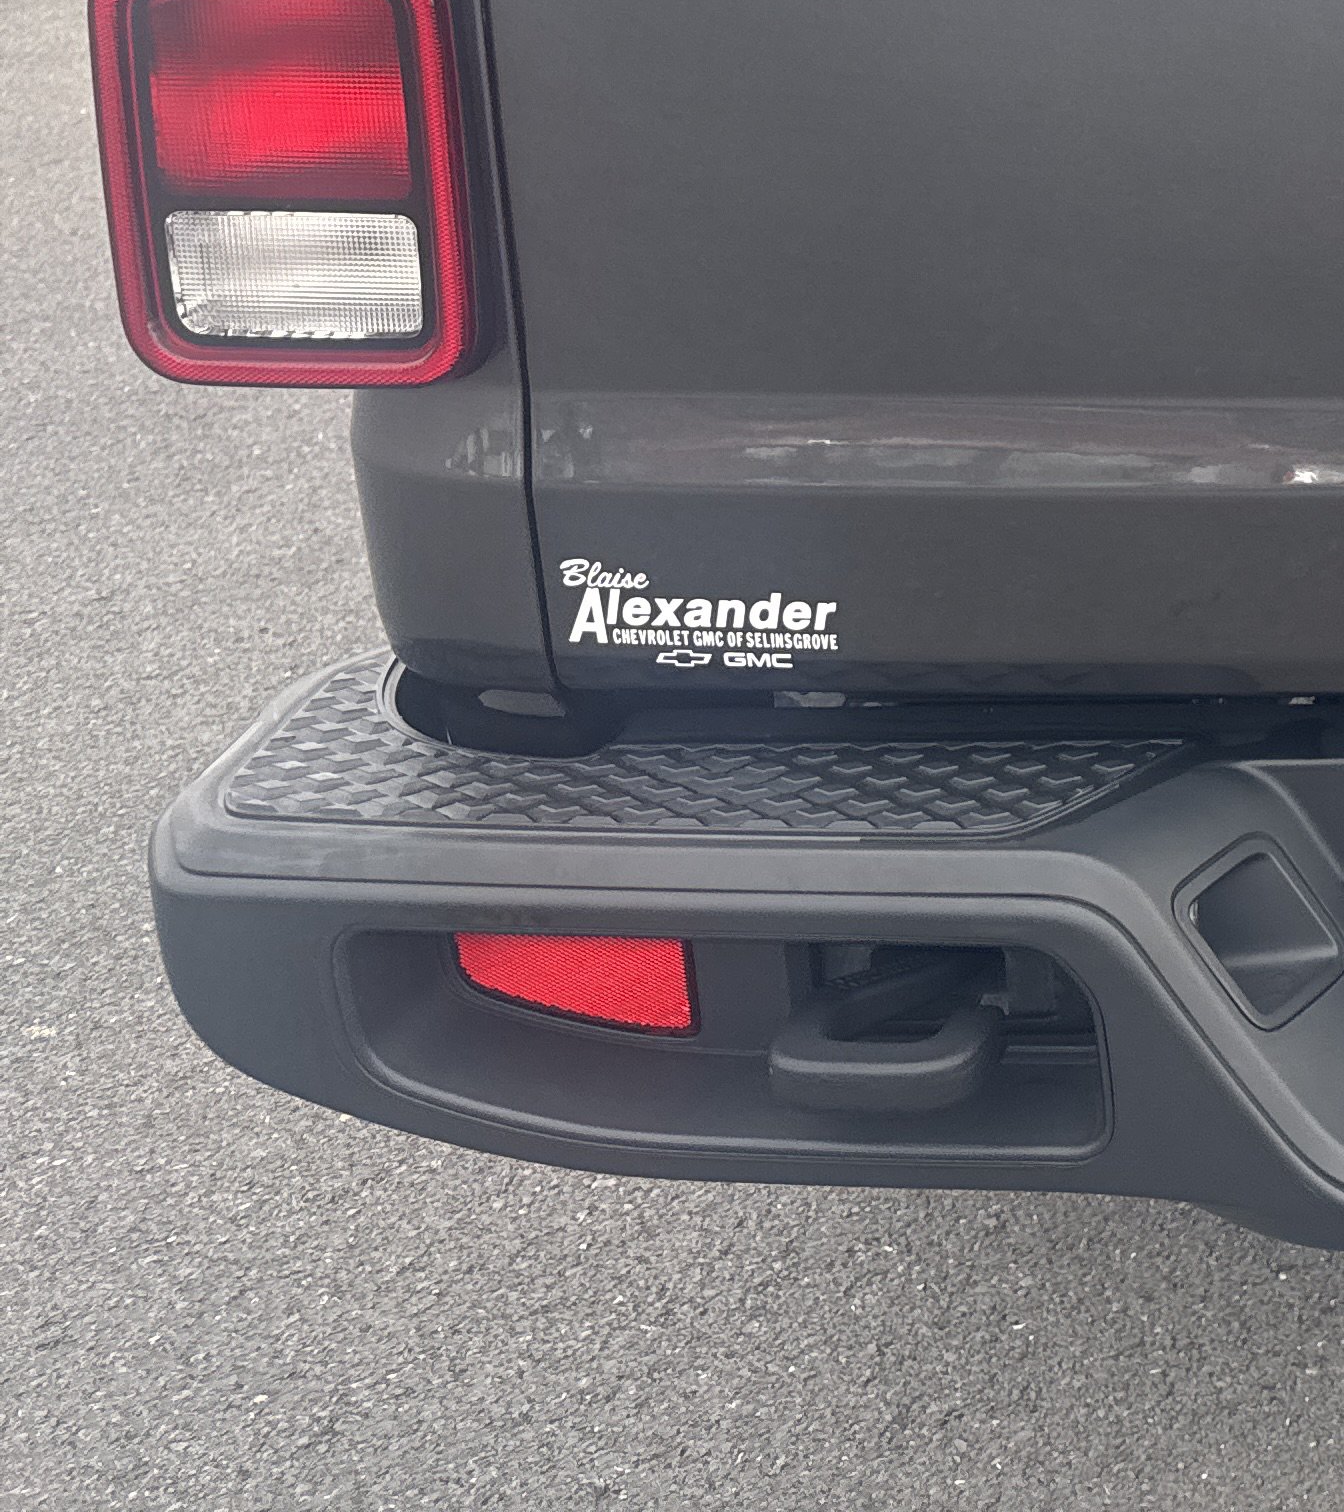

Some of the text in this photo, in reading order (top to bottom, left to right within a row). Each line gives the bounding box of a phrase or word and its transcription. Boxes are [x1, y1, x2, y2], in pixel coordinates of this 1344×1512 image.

[559, 558, 649, 589] Blaise
[568, 587, 838, 644] Alexander
[612, 628, 839, 650] CHEVROLET GMC OF SELINSGROVE
[723, 651, 793, 669] GMC
